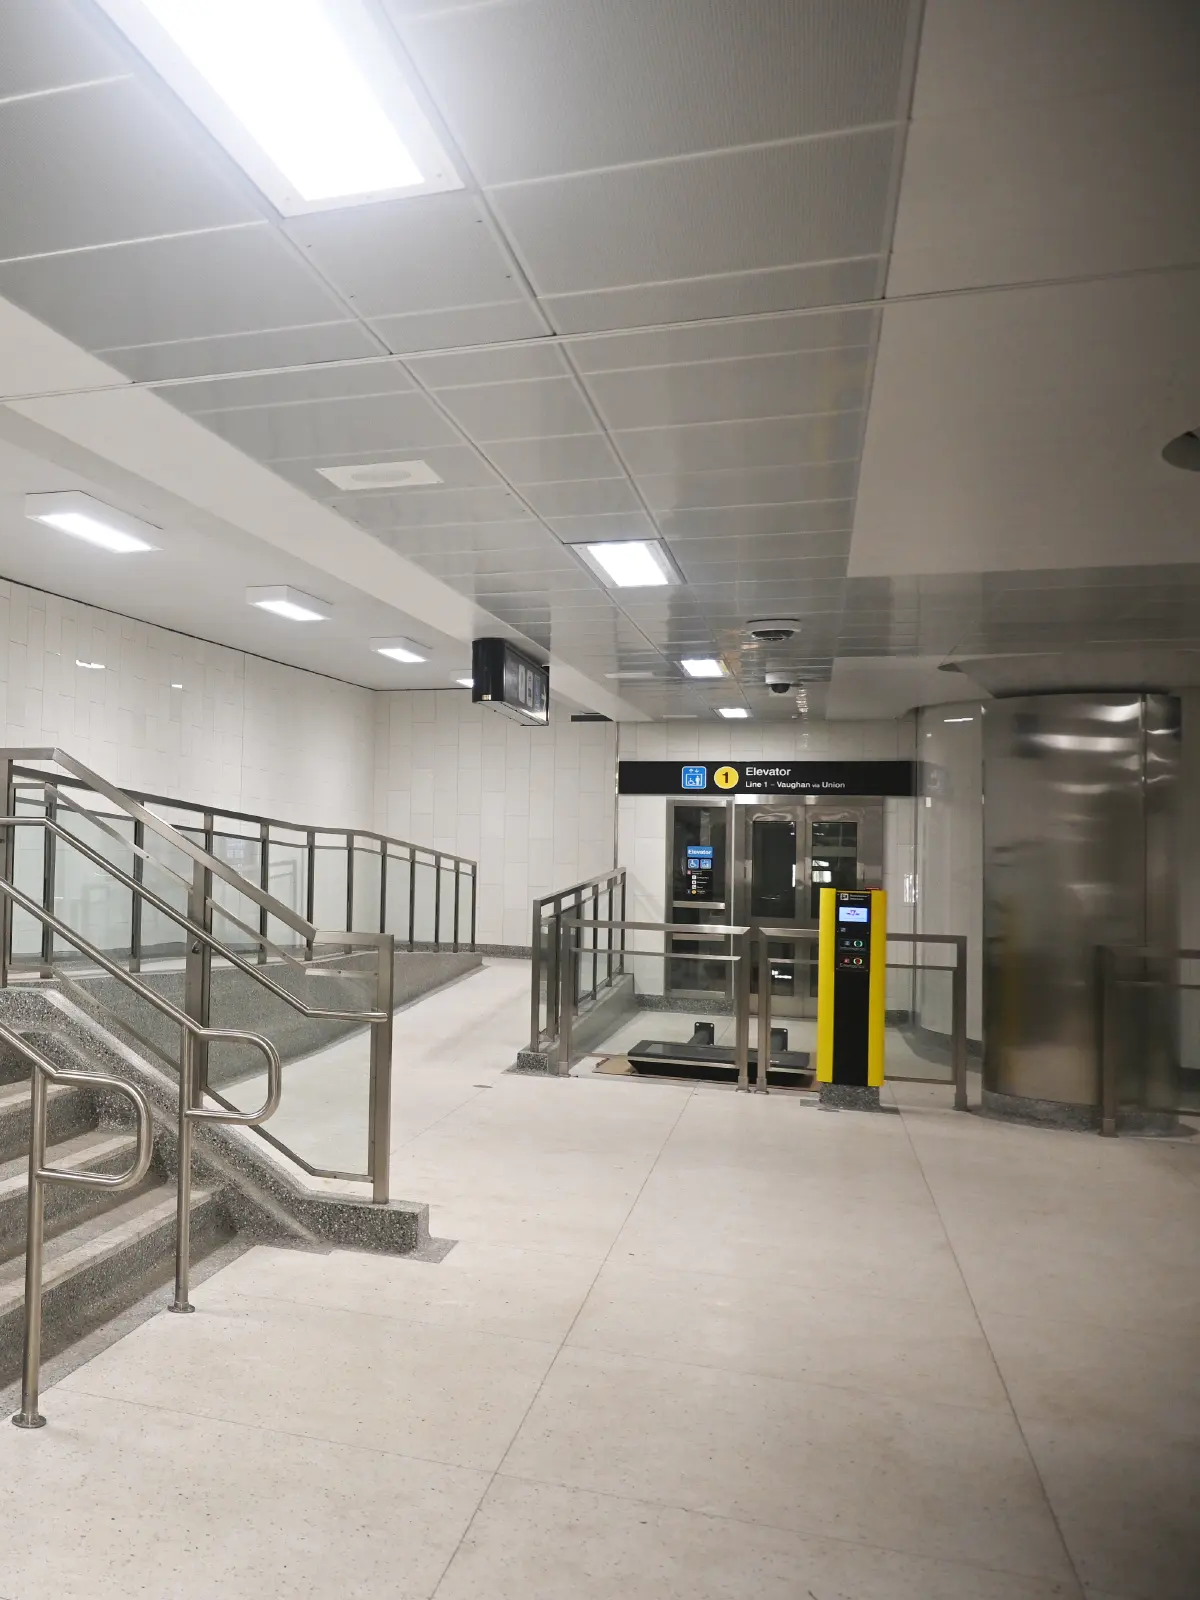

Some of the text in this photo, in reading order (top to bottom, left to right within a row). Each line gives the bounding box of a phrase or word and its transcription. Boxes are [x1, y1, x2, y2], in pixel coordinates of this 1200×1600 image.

[745, 766, 792, 777] Elevator
[722, 771, 729, 784] 1
[745, 780, 762, 788] Line
[776, 781, 811, 789] Vaughan
